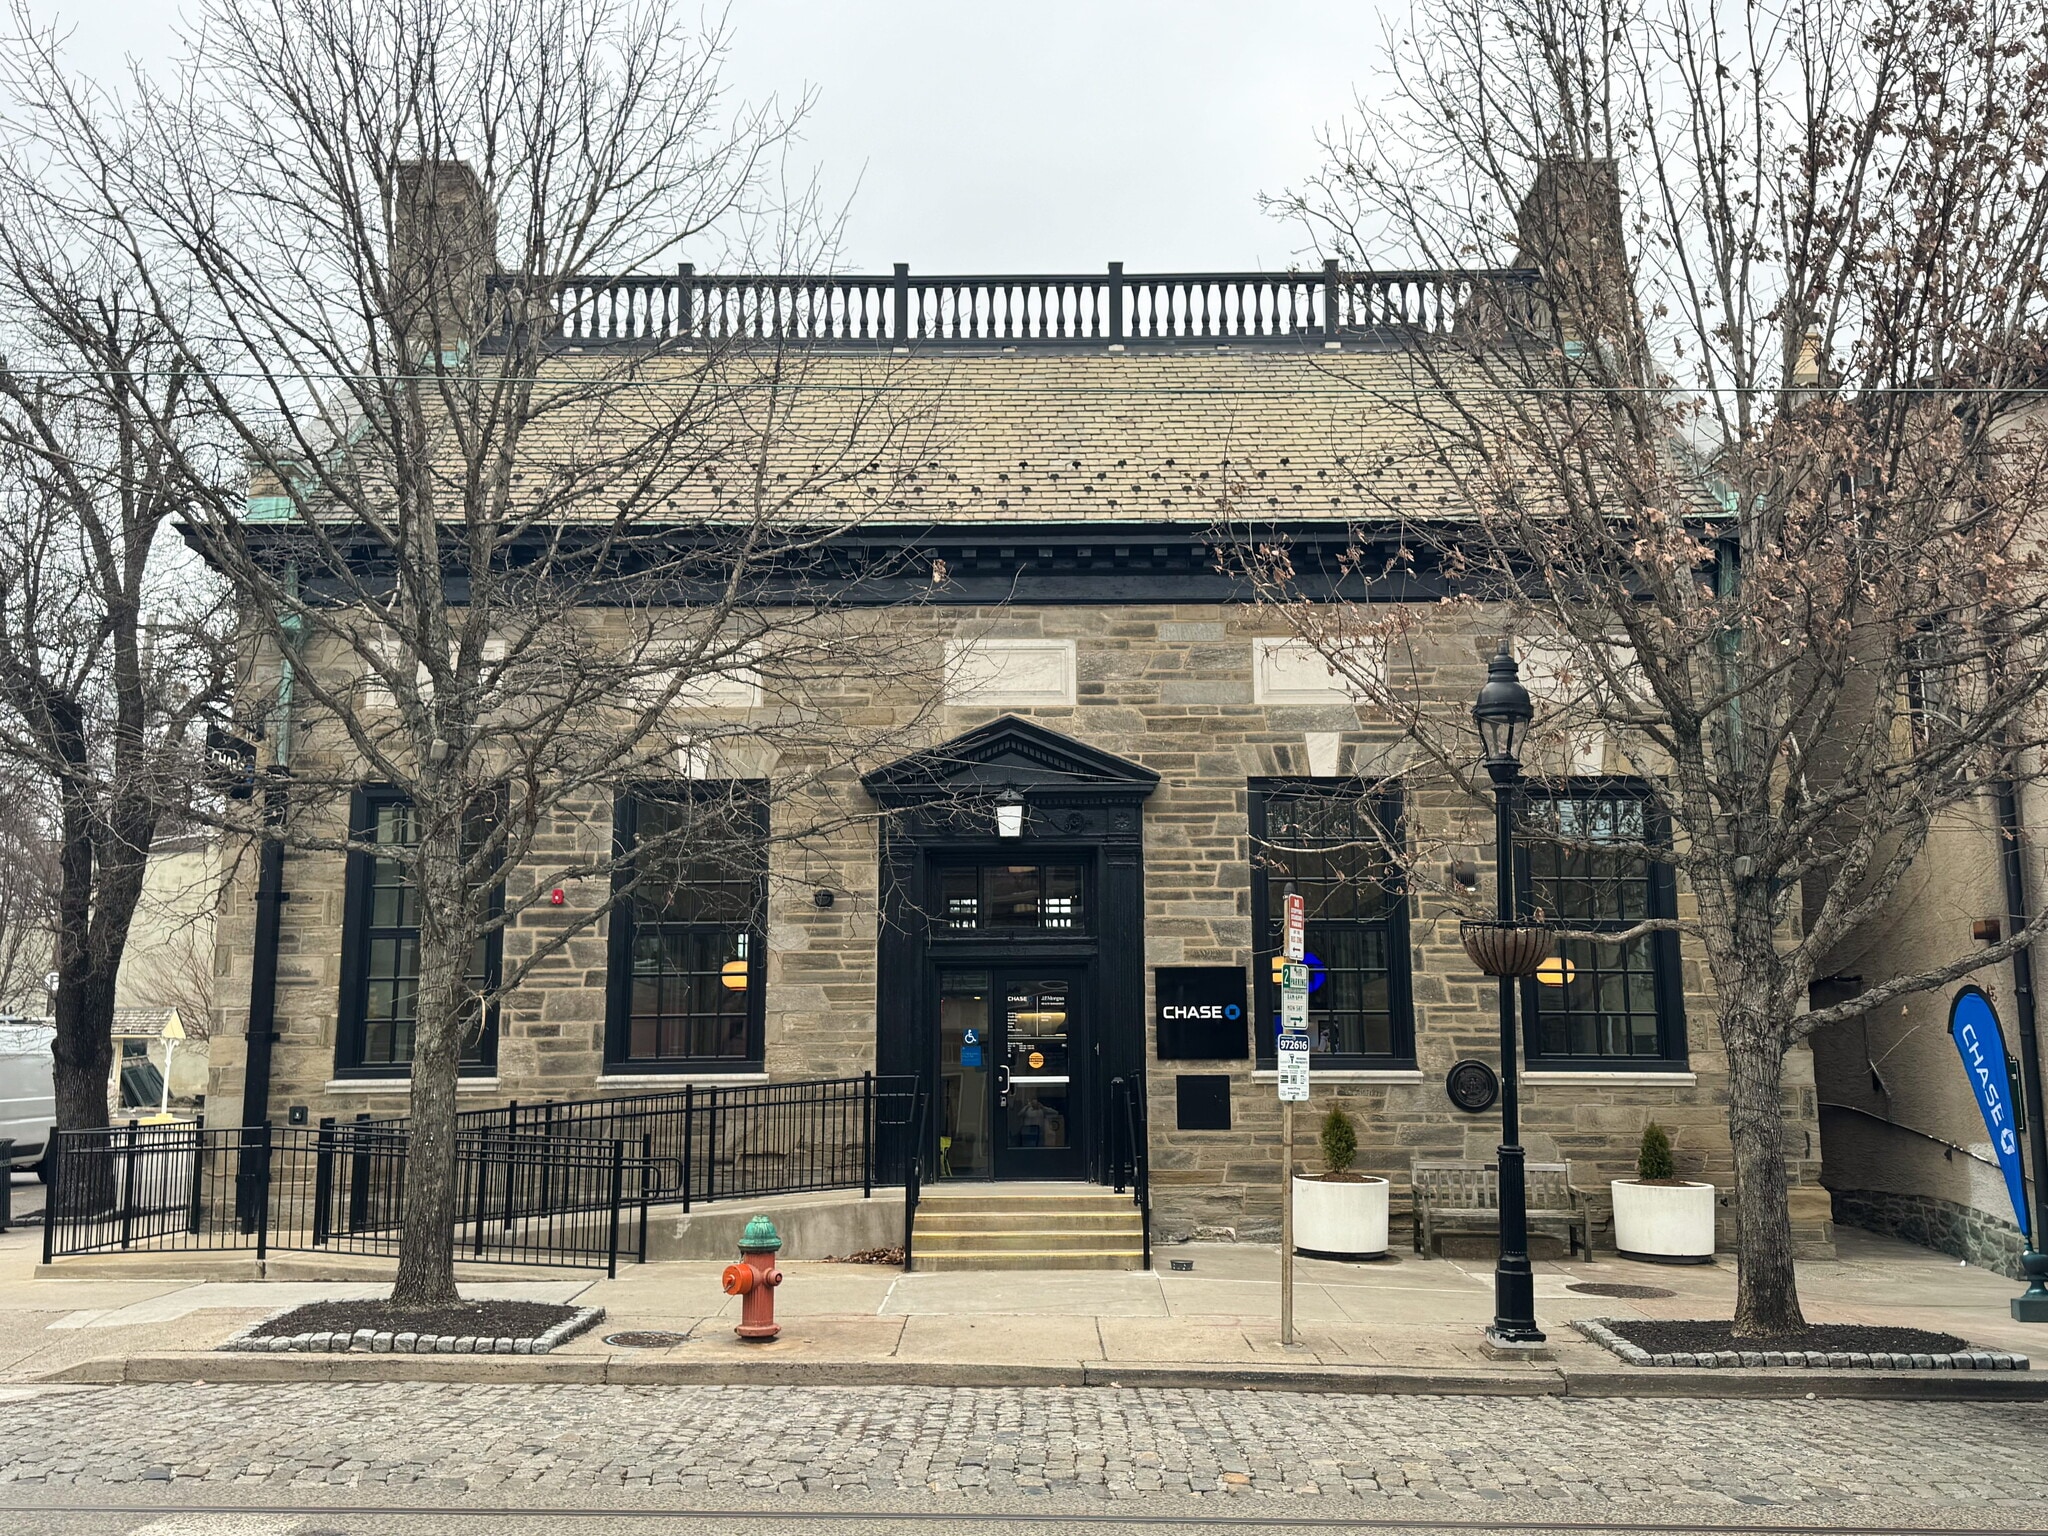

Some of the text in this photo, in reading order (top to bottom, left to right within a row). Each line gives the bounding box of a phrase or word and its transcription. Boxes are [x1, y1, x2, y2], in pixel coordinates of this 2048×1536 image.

[1284, 968, 1289, 985] 2
[1290, 978, 1306, 987] PARKING
[1163, 1005, 1222, 1019] CHASE
[1280, 1040, 1308, 1050] 972616
[1962, 1023, 2004, 1127] CHASE
